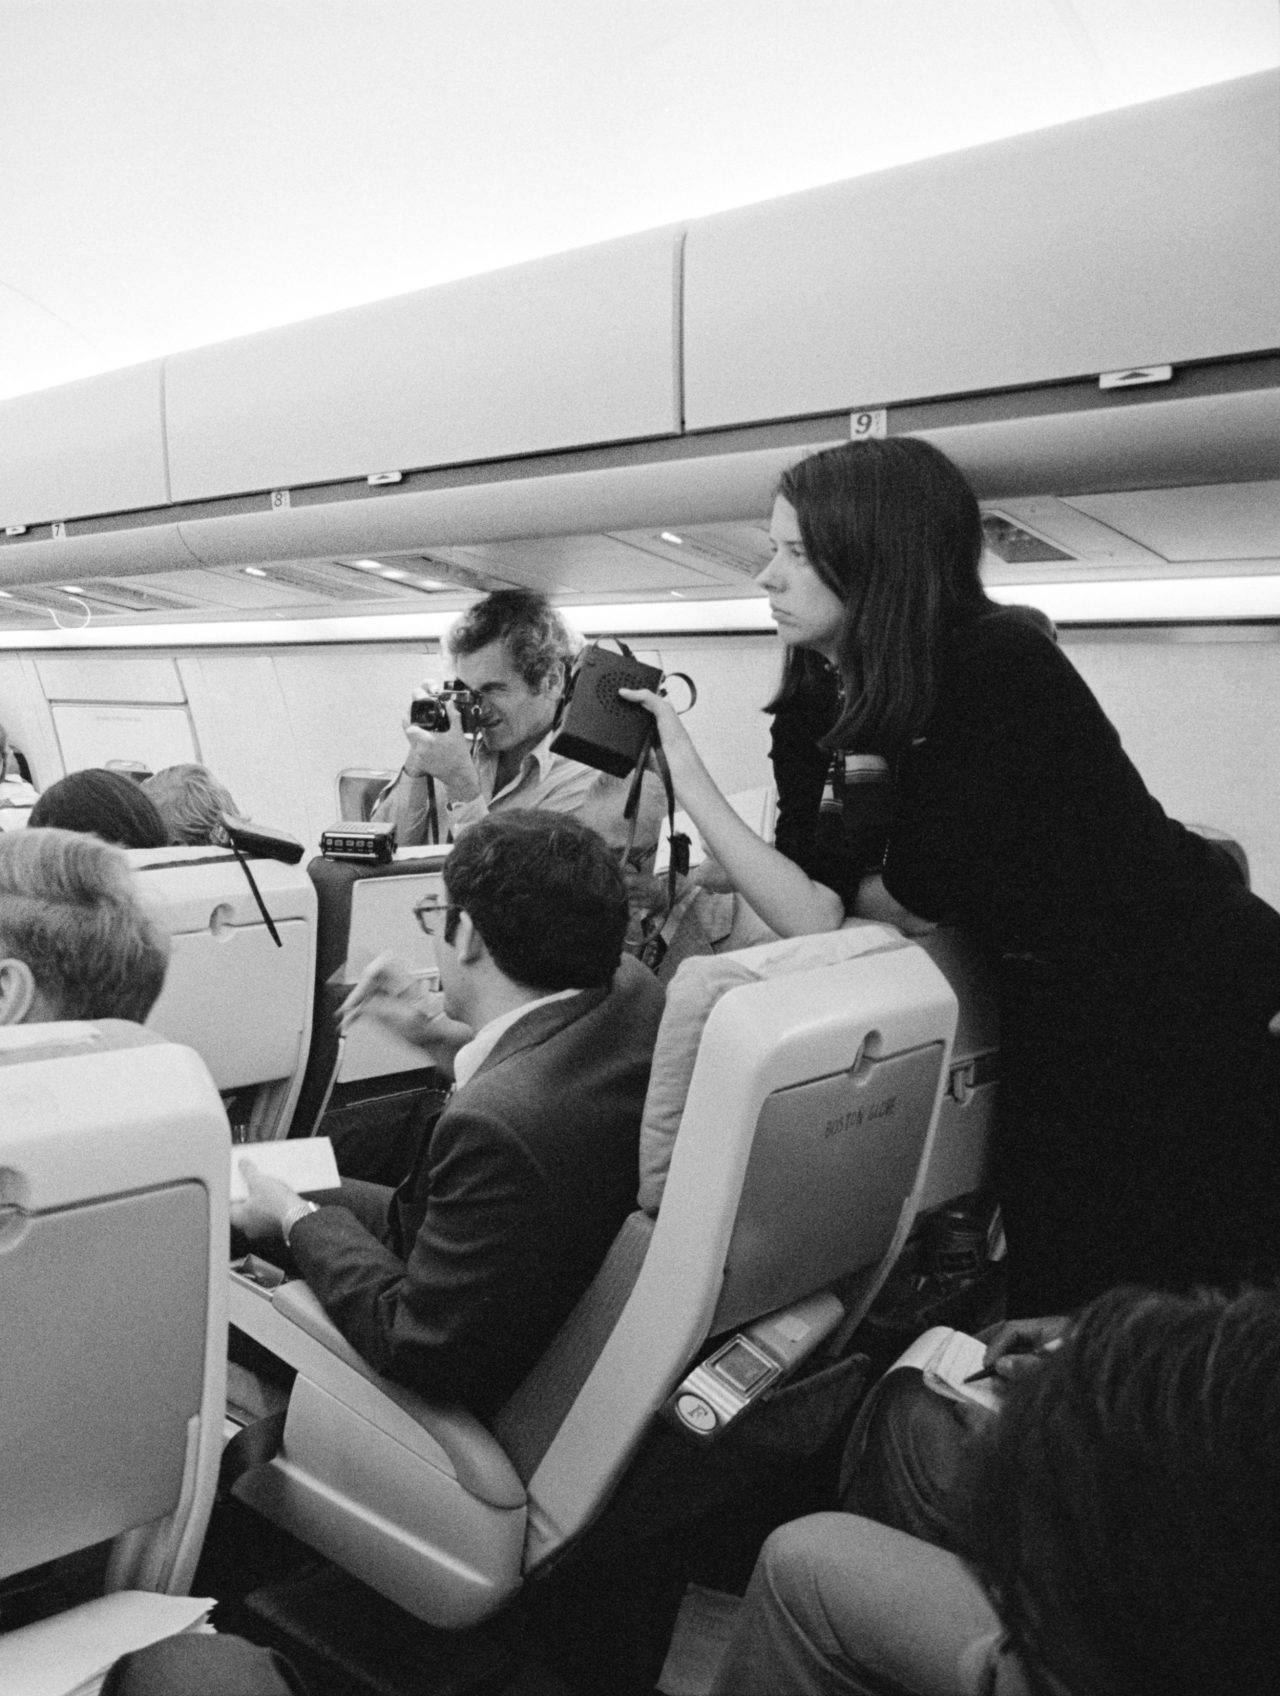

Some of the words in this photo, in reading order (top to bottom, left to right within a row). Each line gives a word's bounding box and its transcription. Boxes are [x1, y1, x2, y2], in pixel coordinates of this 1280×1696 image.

[854, 412, 873, 435] 9
[274, 492, 283, 507] 8
[53, 524, 62, 537] 7
